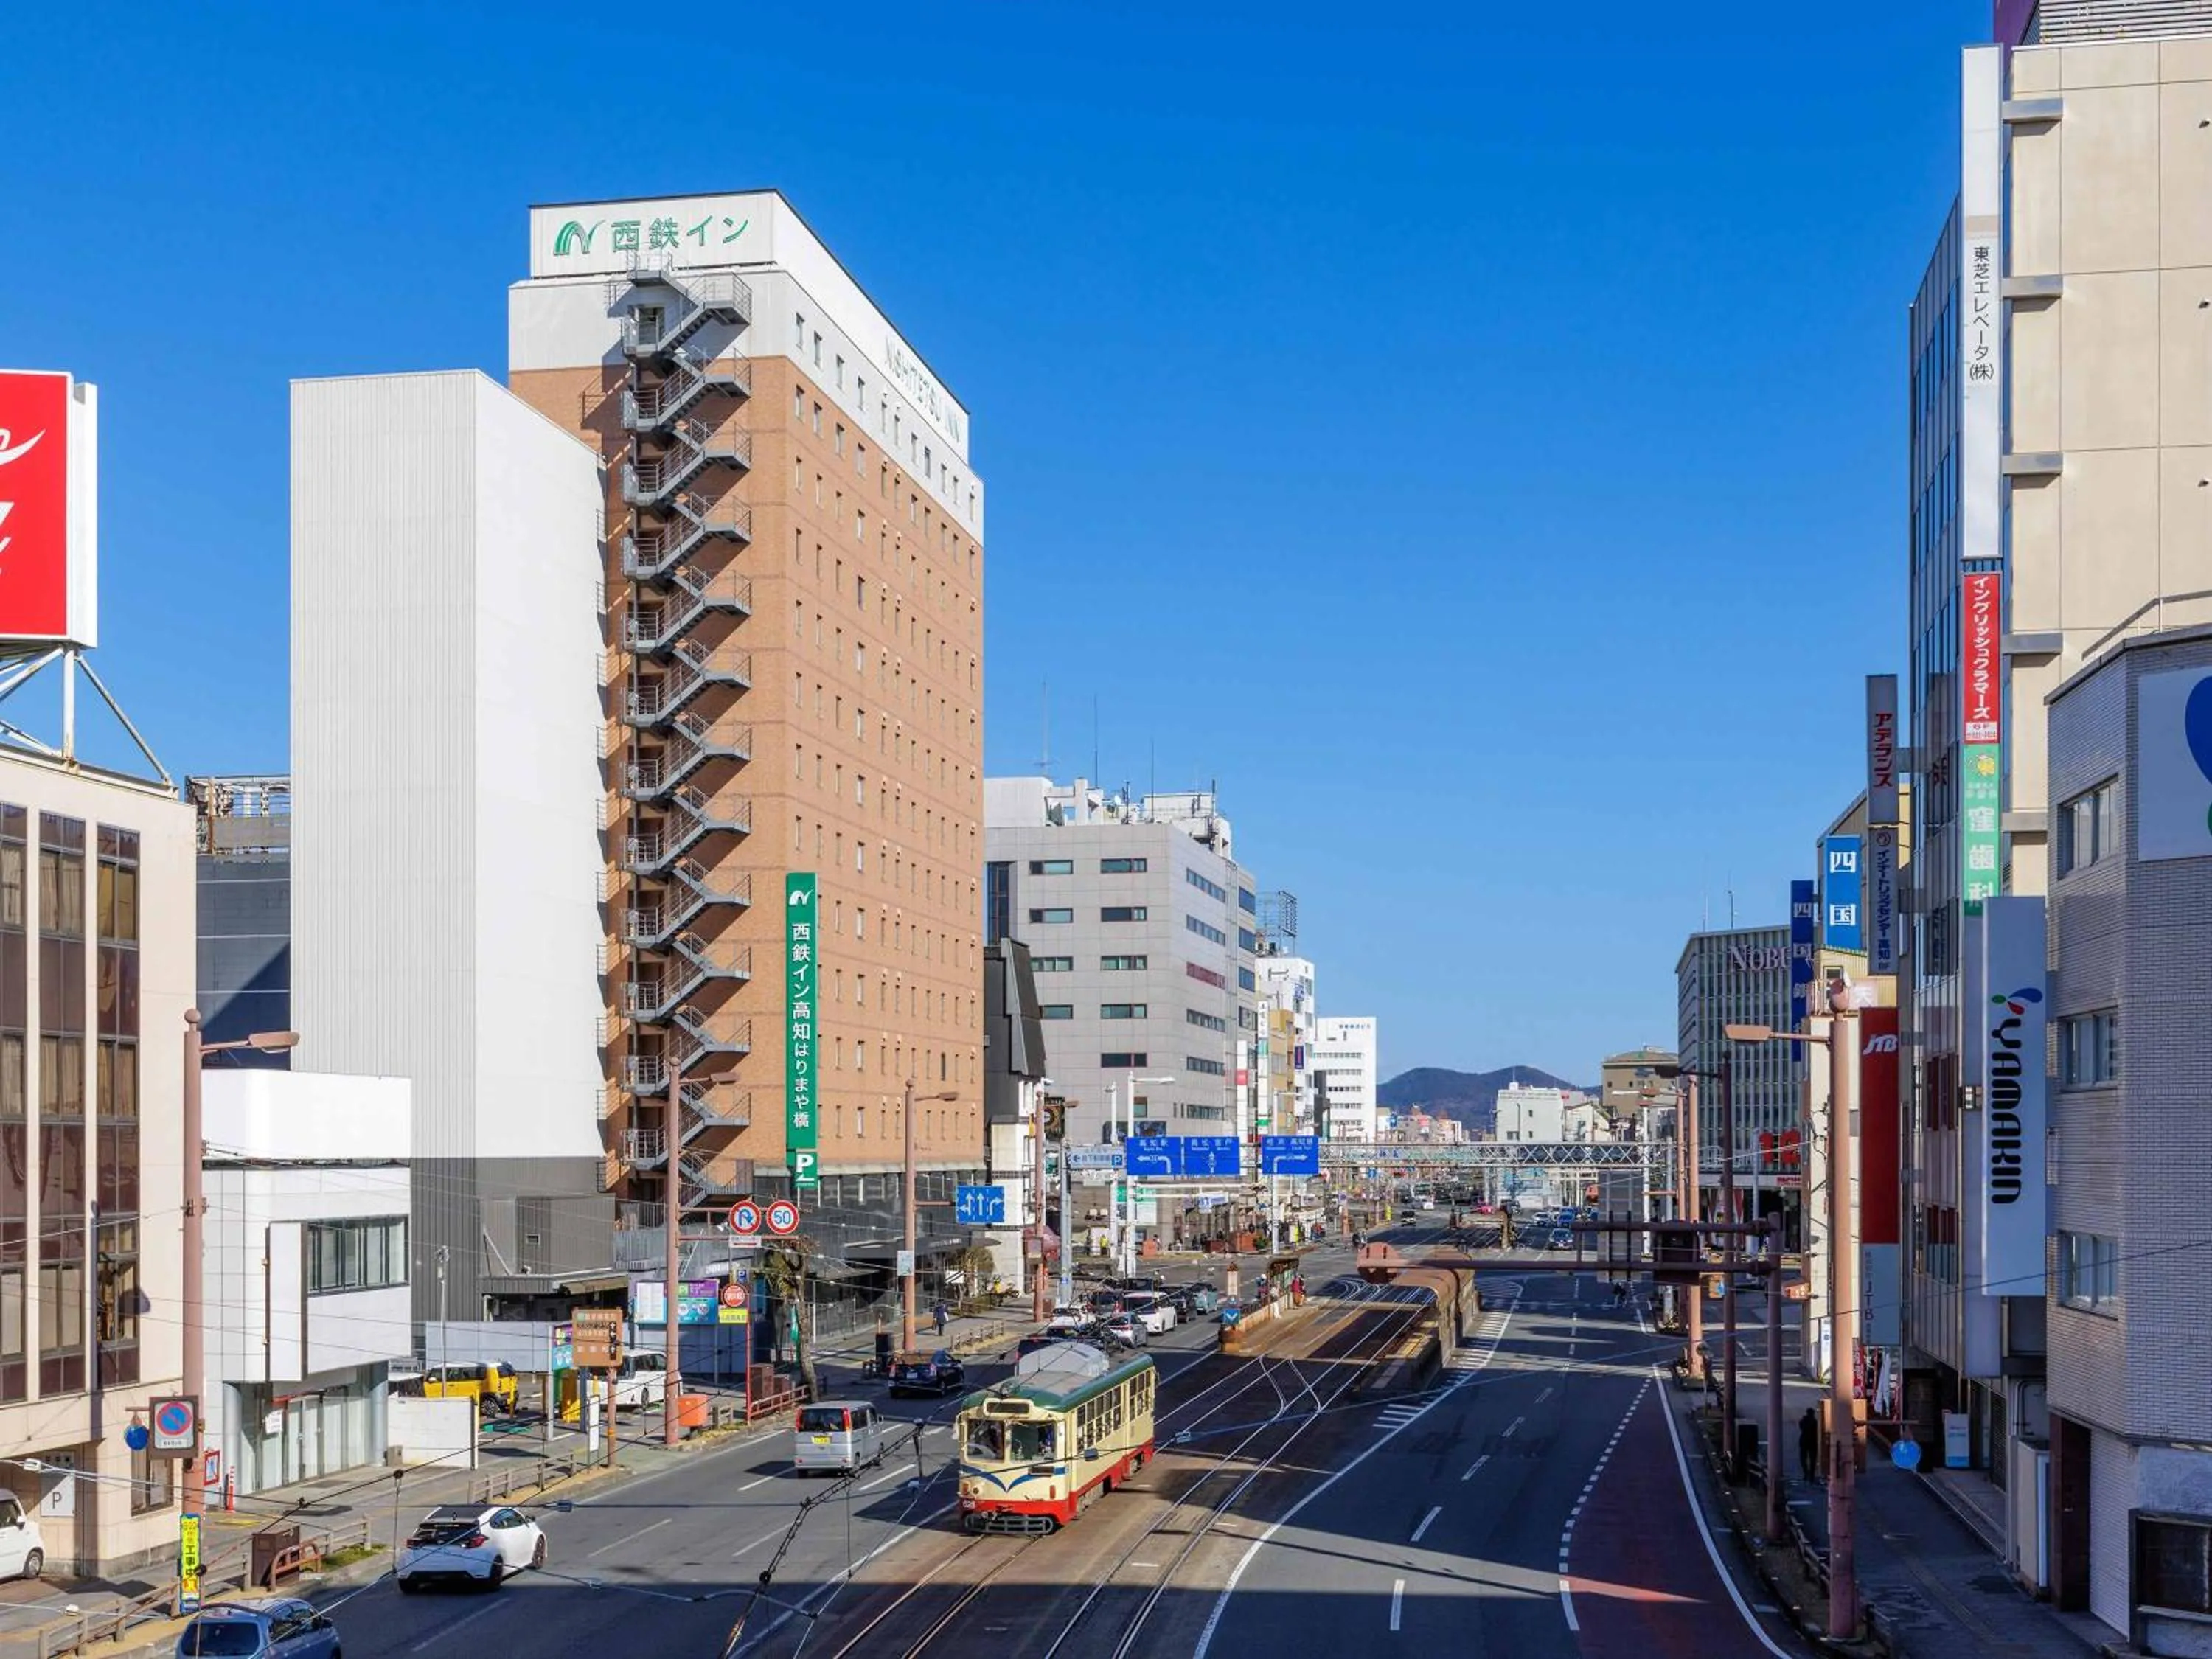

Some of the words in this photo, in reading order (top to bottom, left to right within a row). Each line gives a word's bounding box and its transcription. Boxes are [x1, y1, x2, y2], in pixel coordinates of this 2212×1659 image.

[611, 215, 749, 254] 西鉄イン
[1970, 246, 1994, 381] 東芝エレベータ(株)
[1874, 712, 1893, 788] アデランス
[791, 922, 811, 1128] 西鉄イン高知はりまや橋
[1863, 1034, 1898, 1055] JTB
[1991, 1017, 2022, 1205] YAMAKIN
[796, 1153, 814, 1172] P
[773, 1210, 791, 1225] 50
[52, 1492, 62, 1509] P
